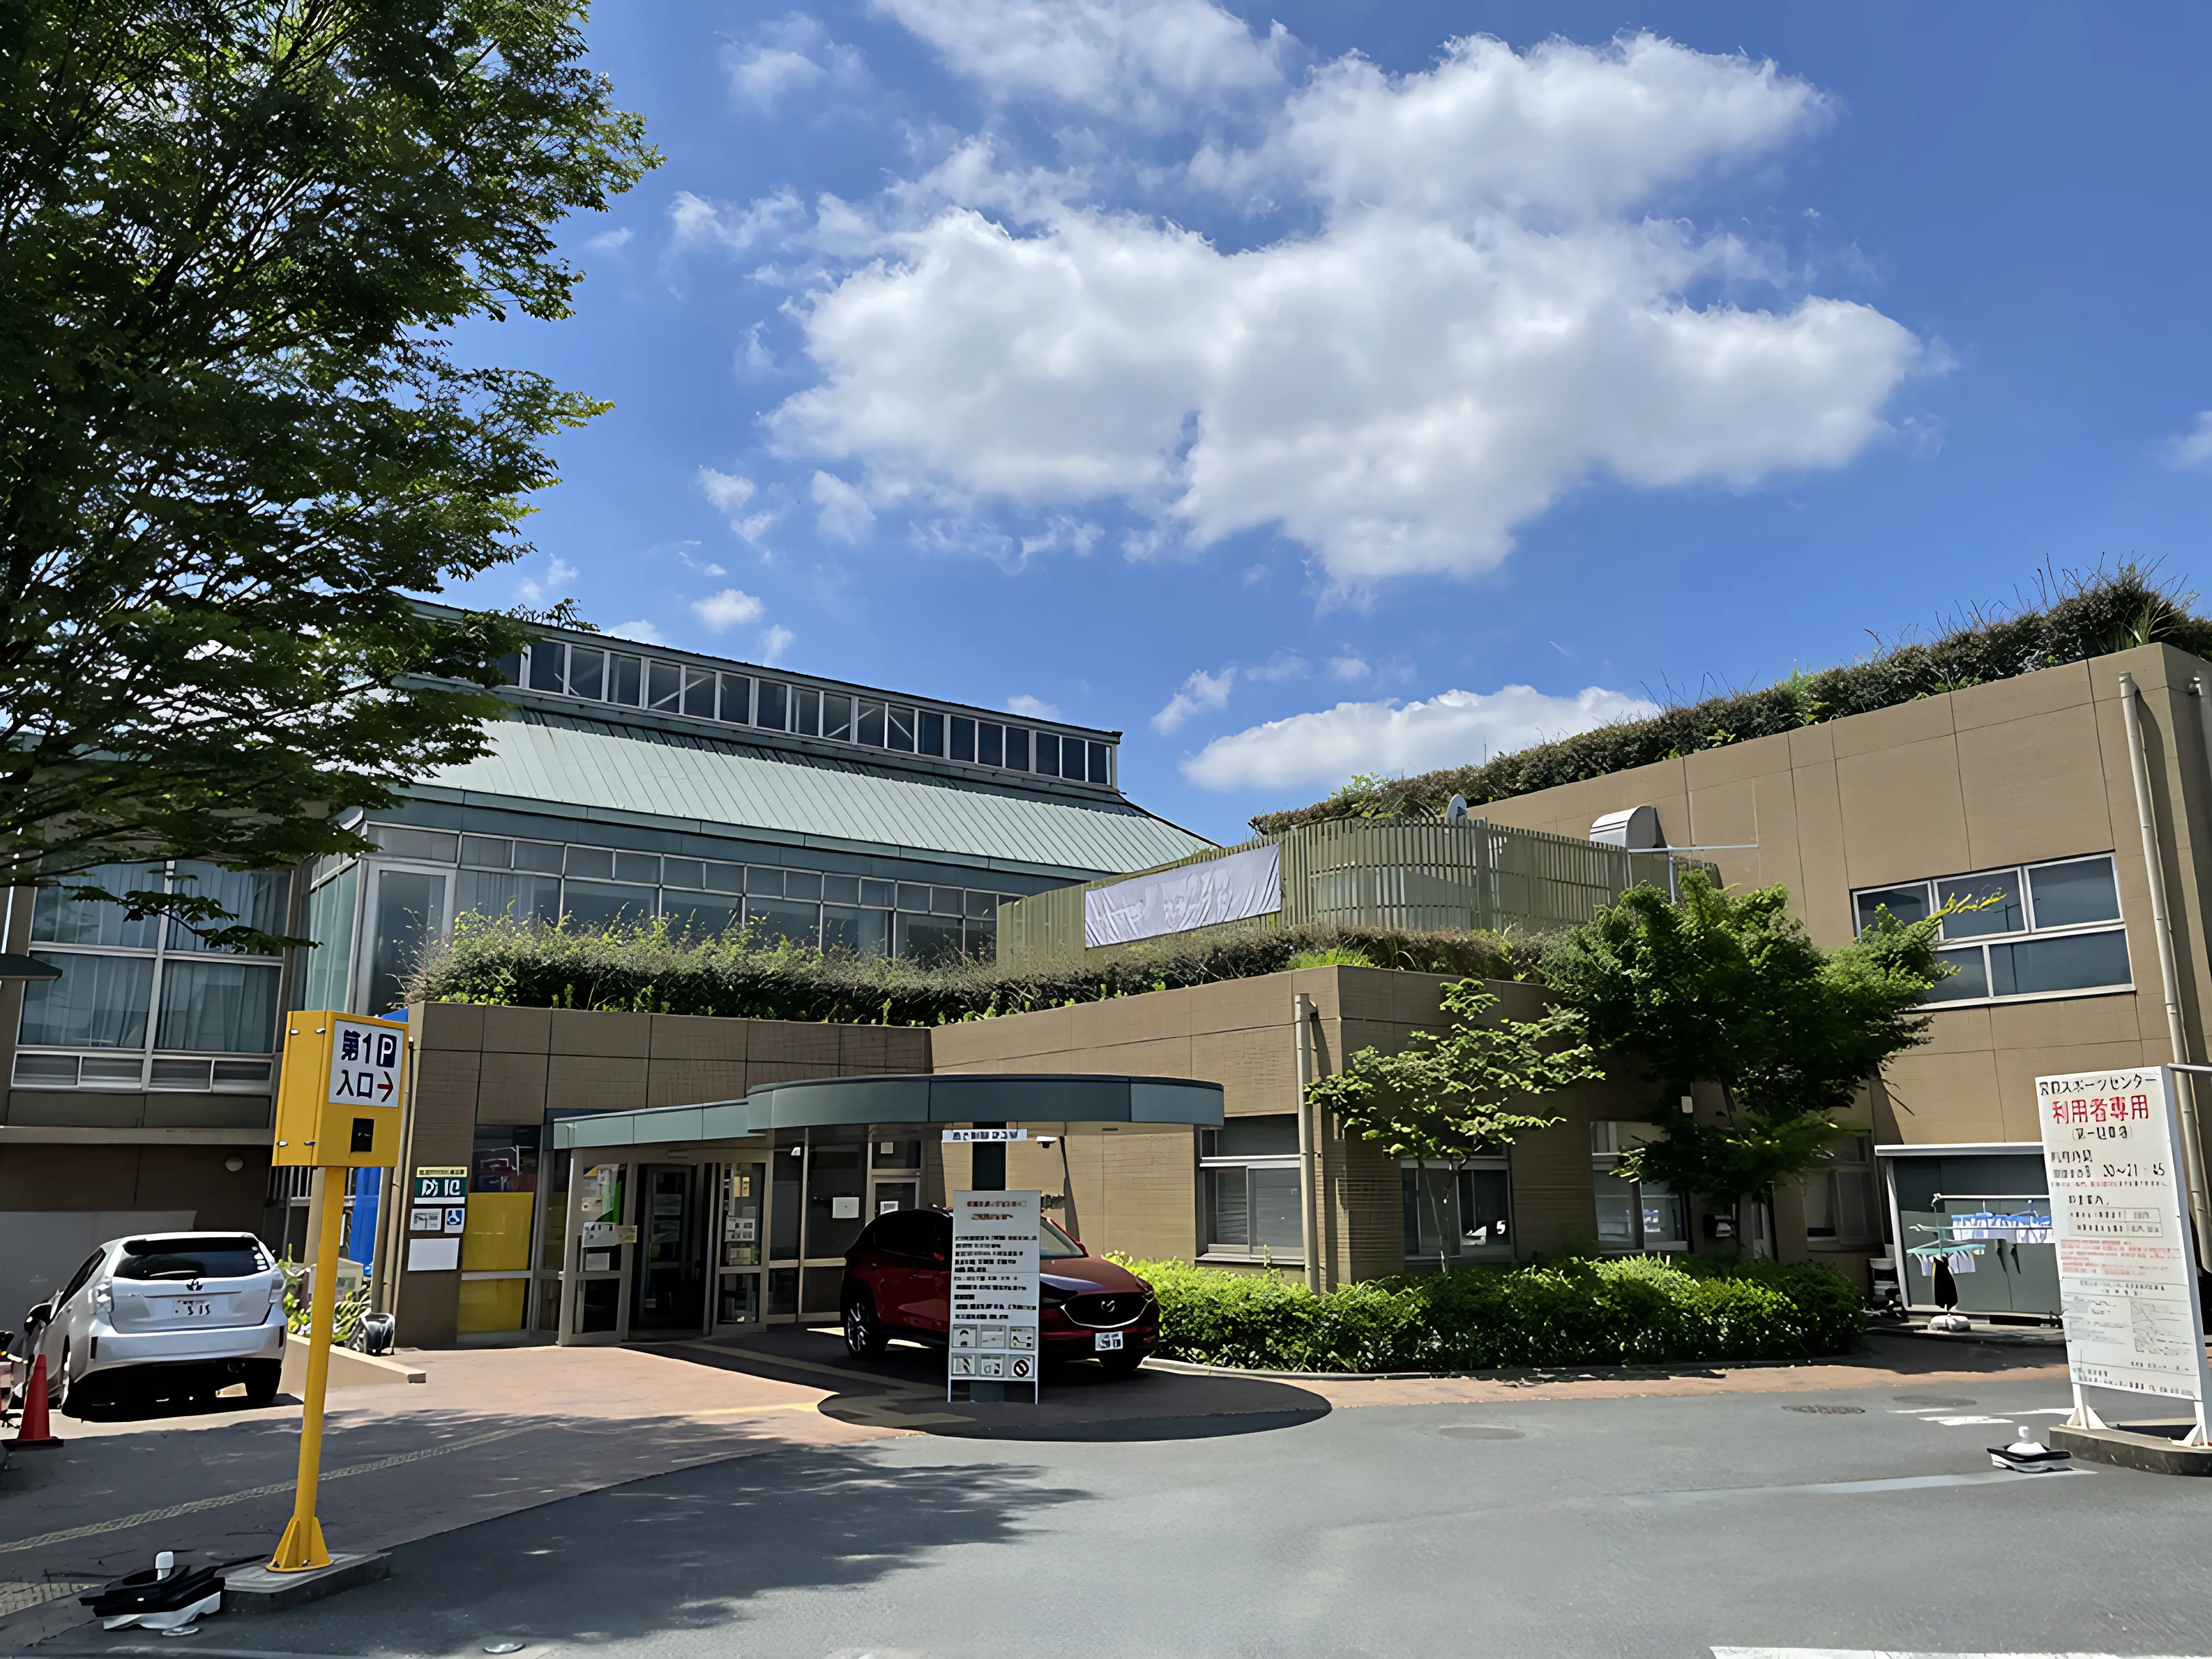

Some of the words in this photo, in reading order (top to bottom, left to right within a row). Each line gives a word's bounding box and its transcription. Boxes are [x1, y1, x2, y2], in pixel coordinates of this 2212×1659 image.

[336, 1069, 374, 1099] 入口
[2052, 1094, 2150, 1124] 利用者専用
